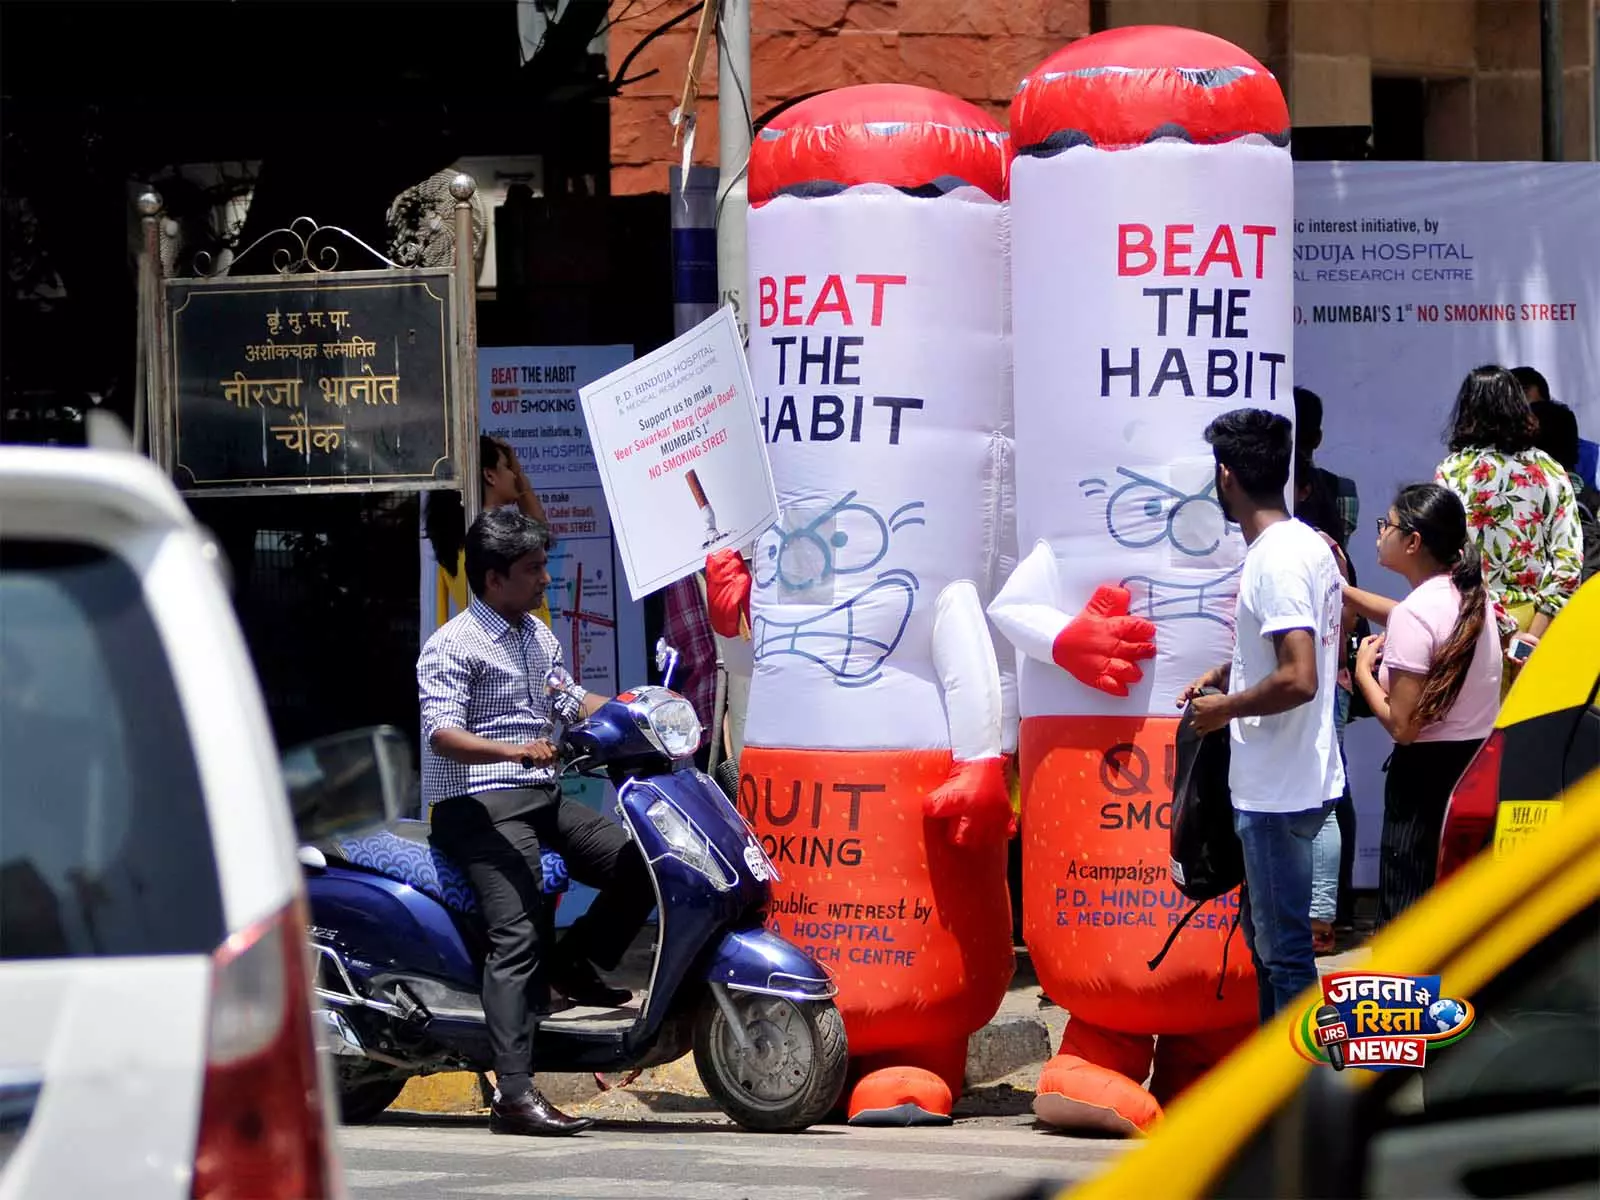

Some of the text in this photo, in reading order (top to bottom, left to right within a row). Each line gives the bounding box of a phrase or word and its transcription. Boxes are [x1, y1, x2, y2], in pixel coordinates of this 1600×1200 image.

[1308, 219, 1357, 233] interest
[1361, 219, 1421, 235] initiative,
[1424, 219, 1439, 235] by
[1118, 223, 1276, 279] BEAT
[1293, 243, 1474, 265] NDUJA HOSPITAL
[1317, 268, 1405, 282] RESEARCH
[1412, 268, 1474, 282] CENTRE
[759, 274, 907, 328] BEAT
[1143, 287, 1251, 338] THE
[1313, 303, 1391, 323] MUMBAI'S
[1417, 304, 1439, 323] NO
[1444, 303, 1515, 322] SMOKING
[1520, 303, 1577, 322] STREET
[246, 338, 318, 361] अशोकचक्र
[771, 336, 864, 385] THE
[220, 364, 400, 408] नीरजा भानोत
[491, 365, 576, 385] BEAT THE HABIT
[634, 368, 673, 395] HINDUJA
[673, 344, 717, 374] HOSPITAL
[1100, 347, 1286, 401] HABIT
[491, 399, 576, 415] QUIT SMOKING
[638, 384, 713, 431] Support us to make
[270, 412, 345, 455] चौक
[614, 446, 633, 462] Veer
[634, 428, 671, 452] Savarkar
[672, 415, 695, 433] Marg
[695, 402, 718, 424] (Cadel
[660, 426, 702, 456] MUMBAI'S
[543, 444, 594, 458] HOSPITA
[648, 428, 728, 480] NO SMOKING STREET
[738, 772, 886, 831] QUIT
[757, 833, 863, 868] OKING
[771, 891, 818, 919] public
[914, 897, 932, 925] by
[1057, 911, 1068, 926] &
[1078, 911, 1156, 927] MEDICAL
[793, 921, 895, 943] HOSPITAL
[848, 947, 917, 966] CENTRE
